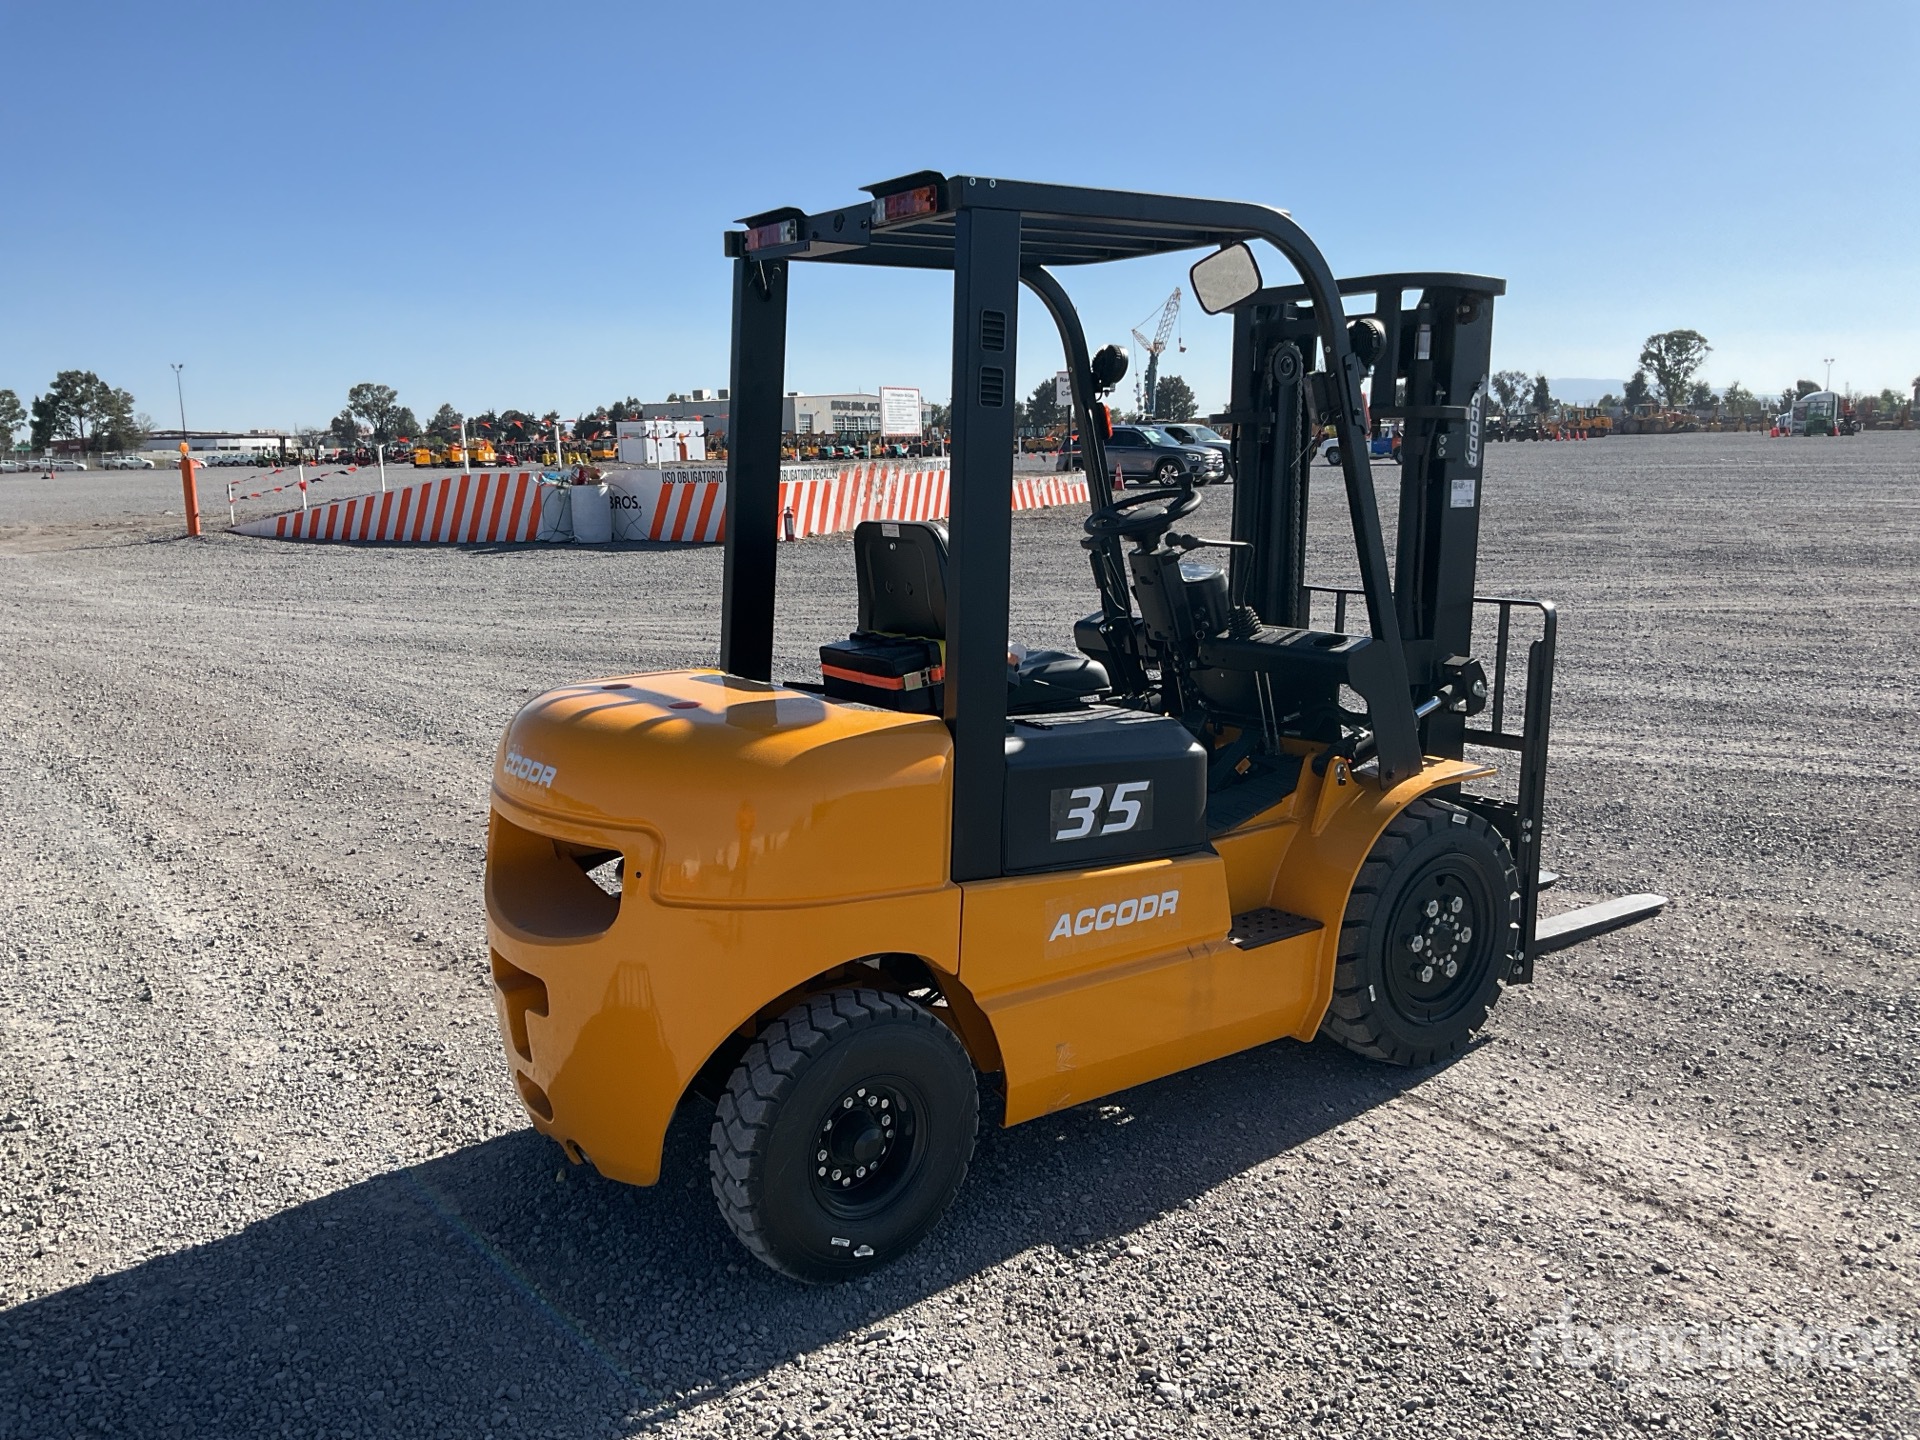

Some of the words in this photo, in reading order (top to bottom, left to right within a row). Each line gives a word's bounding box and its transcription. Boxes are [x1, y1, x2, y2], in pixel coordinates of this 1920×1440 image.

[1465, 392, 1482, 468] CCODR
[661, 471, 676, 484] USO
[677, 470, 724, 484] OBLIGATORIO
[503, 752, 557, 789] CCODR
[1055, 780, 1150, 841] 35
[1048, 889, 1179, 942] ACCODR
